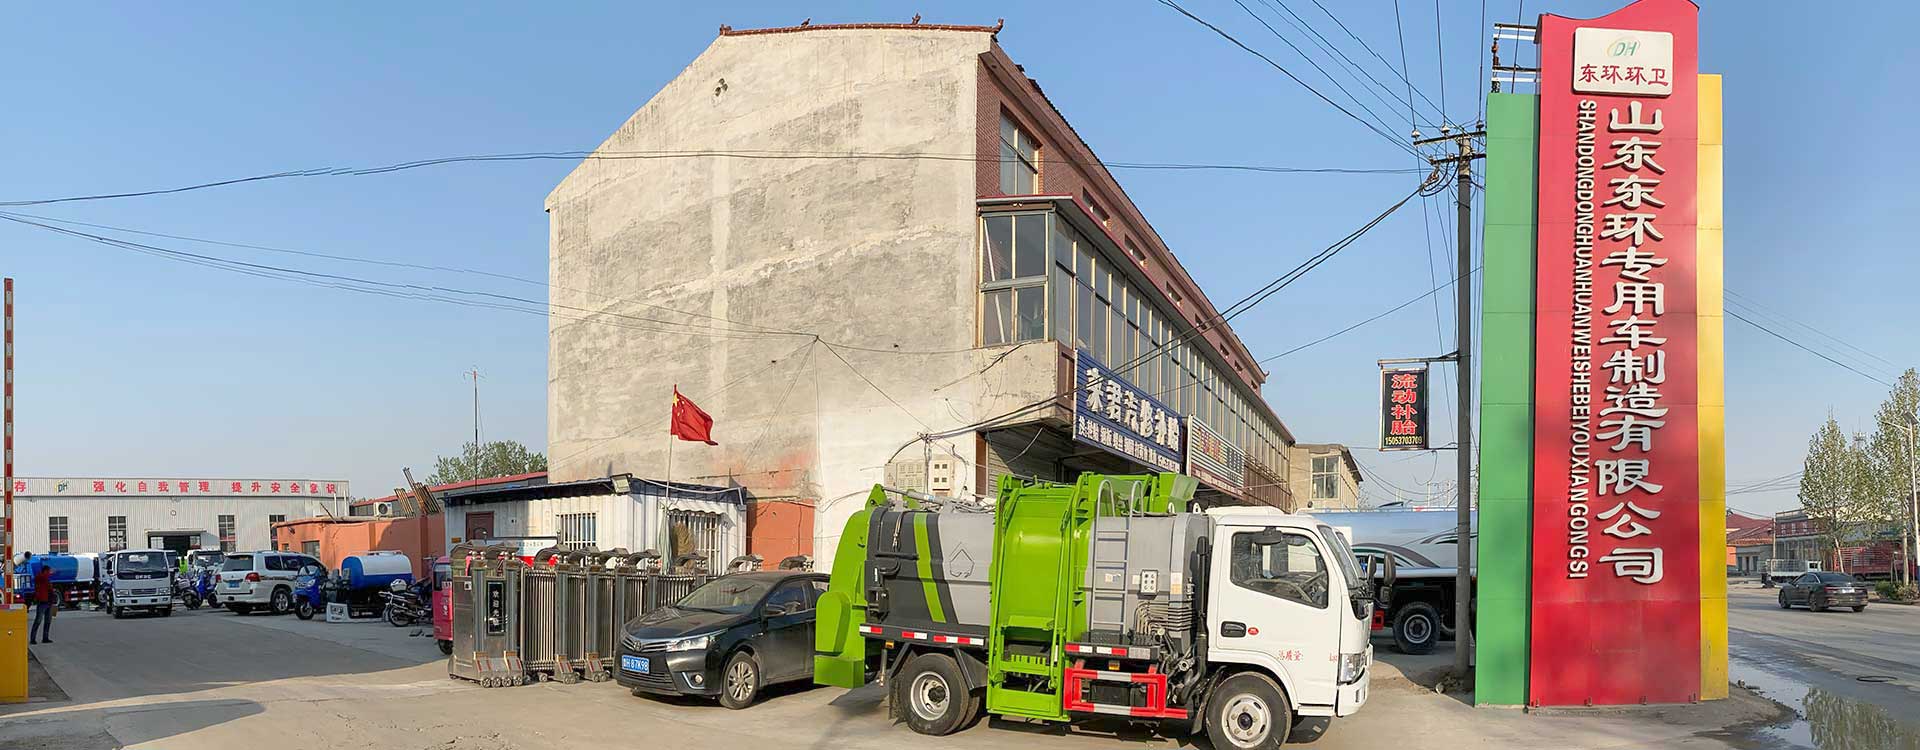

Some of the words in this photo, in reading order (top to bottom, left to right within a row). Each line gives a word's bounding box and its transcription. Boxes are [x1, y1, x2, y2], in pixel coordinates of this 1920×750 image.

[1578, 63, 1669, 87] 东环环卫
[1569, 99, 1597, 578] SHANDONGDONGHUANHUANWEISHEBEIYOUXIANGONGSI
[1594, 100, 1669, 584] 山东东环专用车制造有限公司
[1391, 374, 1417, 435] 流动补胎
[93, 481, 210, 493] 强化自我管理
[232, 482, 336, 494] 提升安全意识
